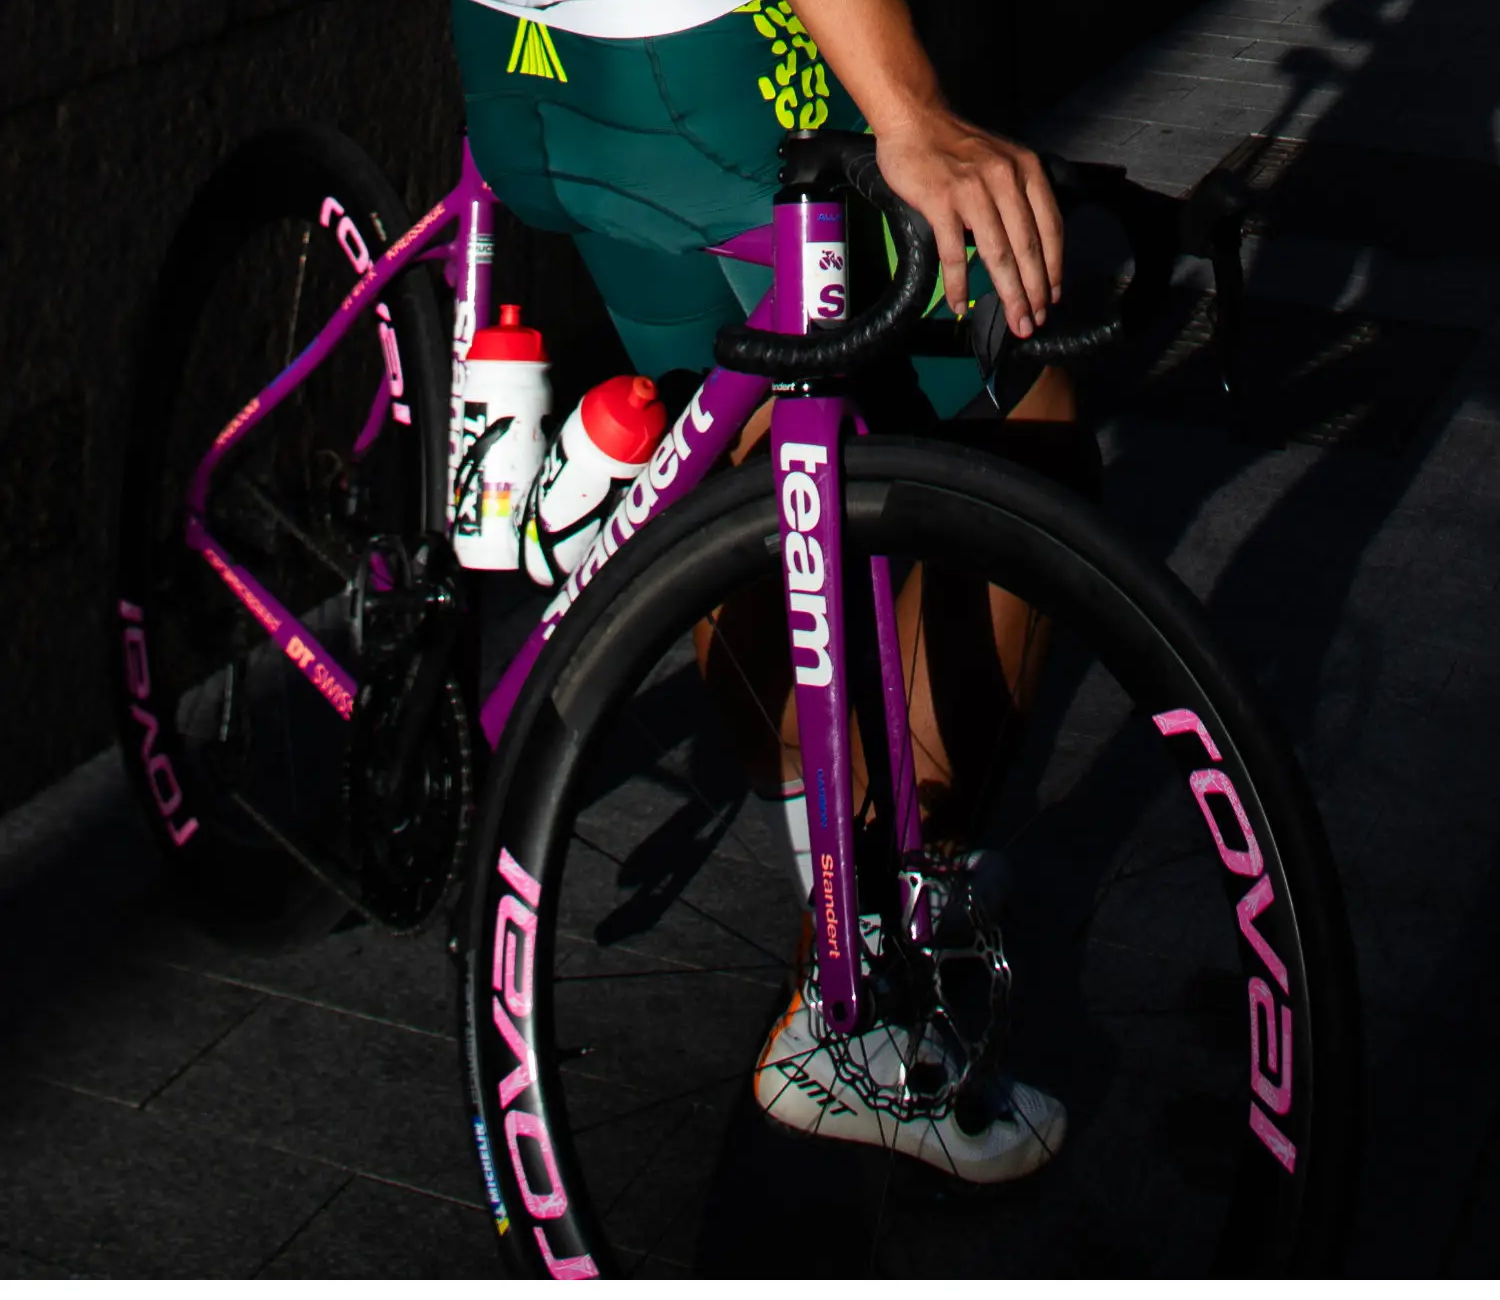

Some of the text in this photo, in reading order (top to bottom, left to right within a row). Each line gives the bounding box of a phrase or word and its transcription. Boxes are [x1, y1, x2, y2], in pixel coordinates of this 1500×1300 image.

[780, 442, 834, 686] team
[285, 635, 316, 668] DT
[820, 852, 841, 960] Standert
[1152, 708, 1297, 1174] roval
[474, 1121, 502, 1205] MICHELIN
